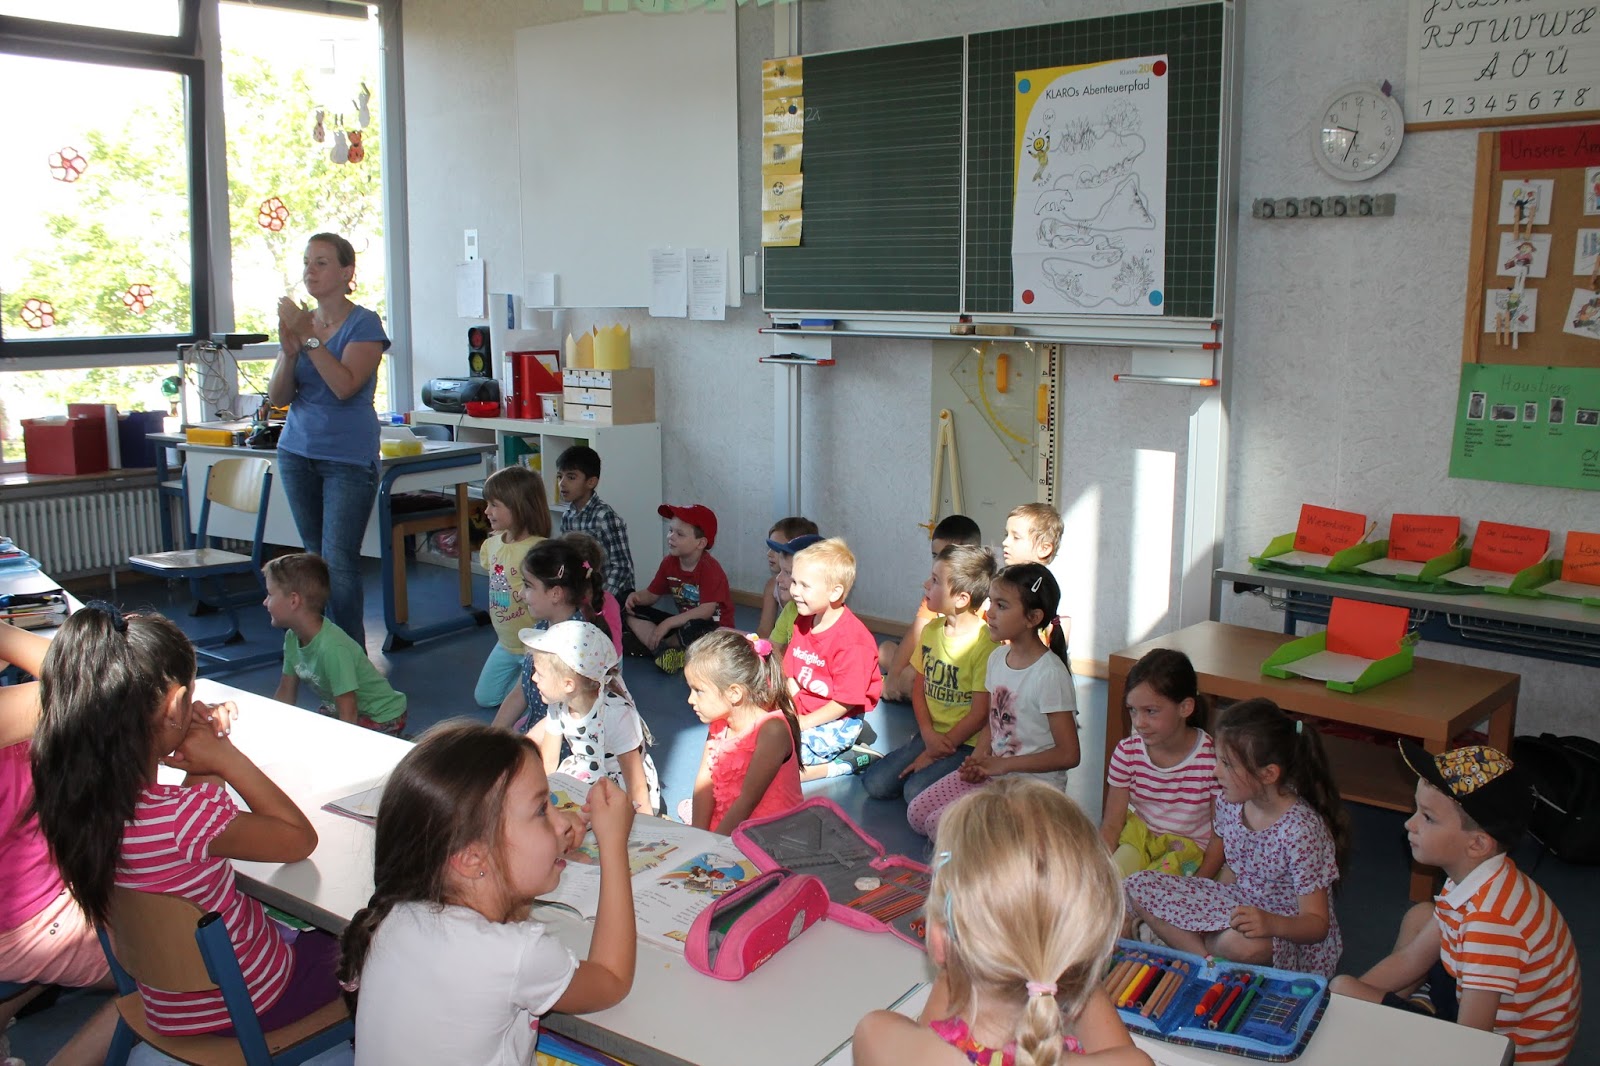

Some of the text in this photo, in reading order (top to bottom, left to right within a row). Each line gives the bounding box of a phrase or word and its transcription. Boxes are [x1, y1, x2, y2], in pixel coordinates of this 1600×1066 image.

[1421, 25, 1443, 50] R
[1474, 45, 1569, 82] Ä Ö Ü
[1045, 78, 1150, 100] KLAROs Abenteuerpfad
[1422, 87, 1591, 117] 1 2 3 4 5 6 7 8
[1510, 136, 1567, 160] Unsere
[1501, 373, 1571, 395] Haustiere
[495, 606, 525, 623] Sweet
